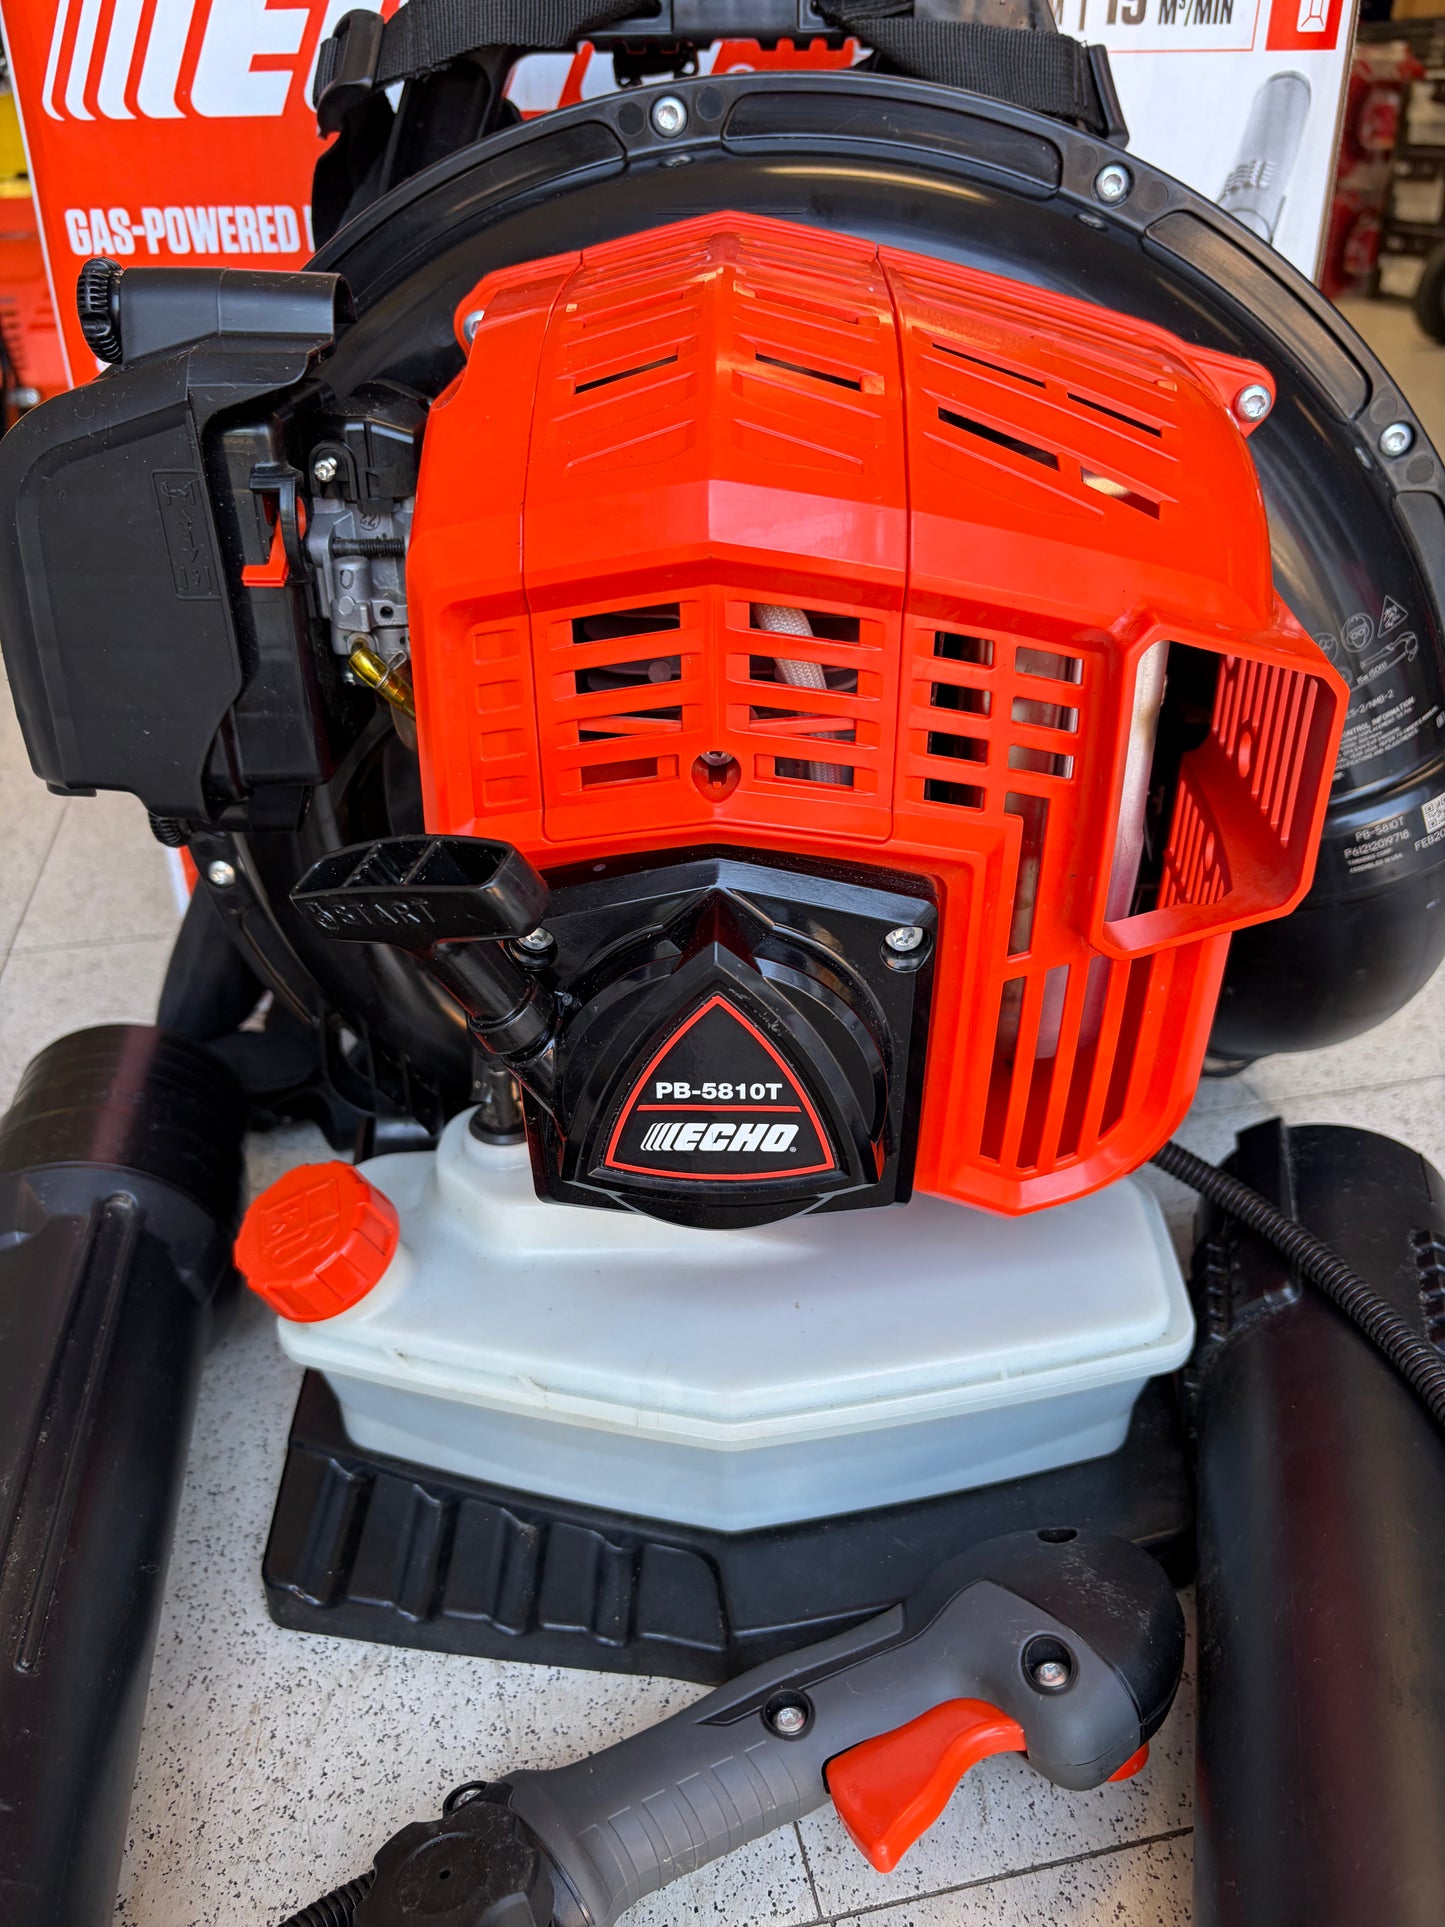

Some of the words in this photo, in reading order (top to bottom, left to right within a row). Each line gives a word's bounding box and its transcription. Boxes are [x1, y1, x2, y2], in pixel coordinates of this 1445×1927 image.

[64, 205, 301, 256] GAS-POWERED
[1342, 722, 1371, 738] ONTROL
[1355, 816, 1404, 842] PB-5810T
[655, 1081, 783, 1100] PB-5810T
[656, 1122, 799, 1153] ECHO
